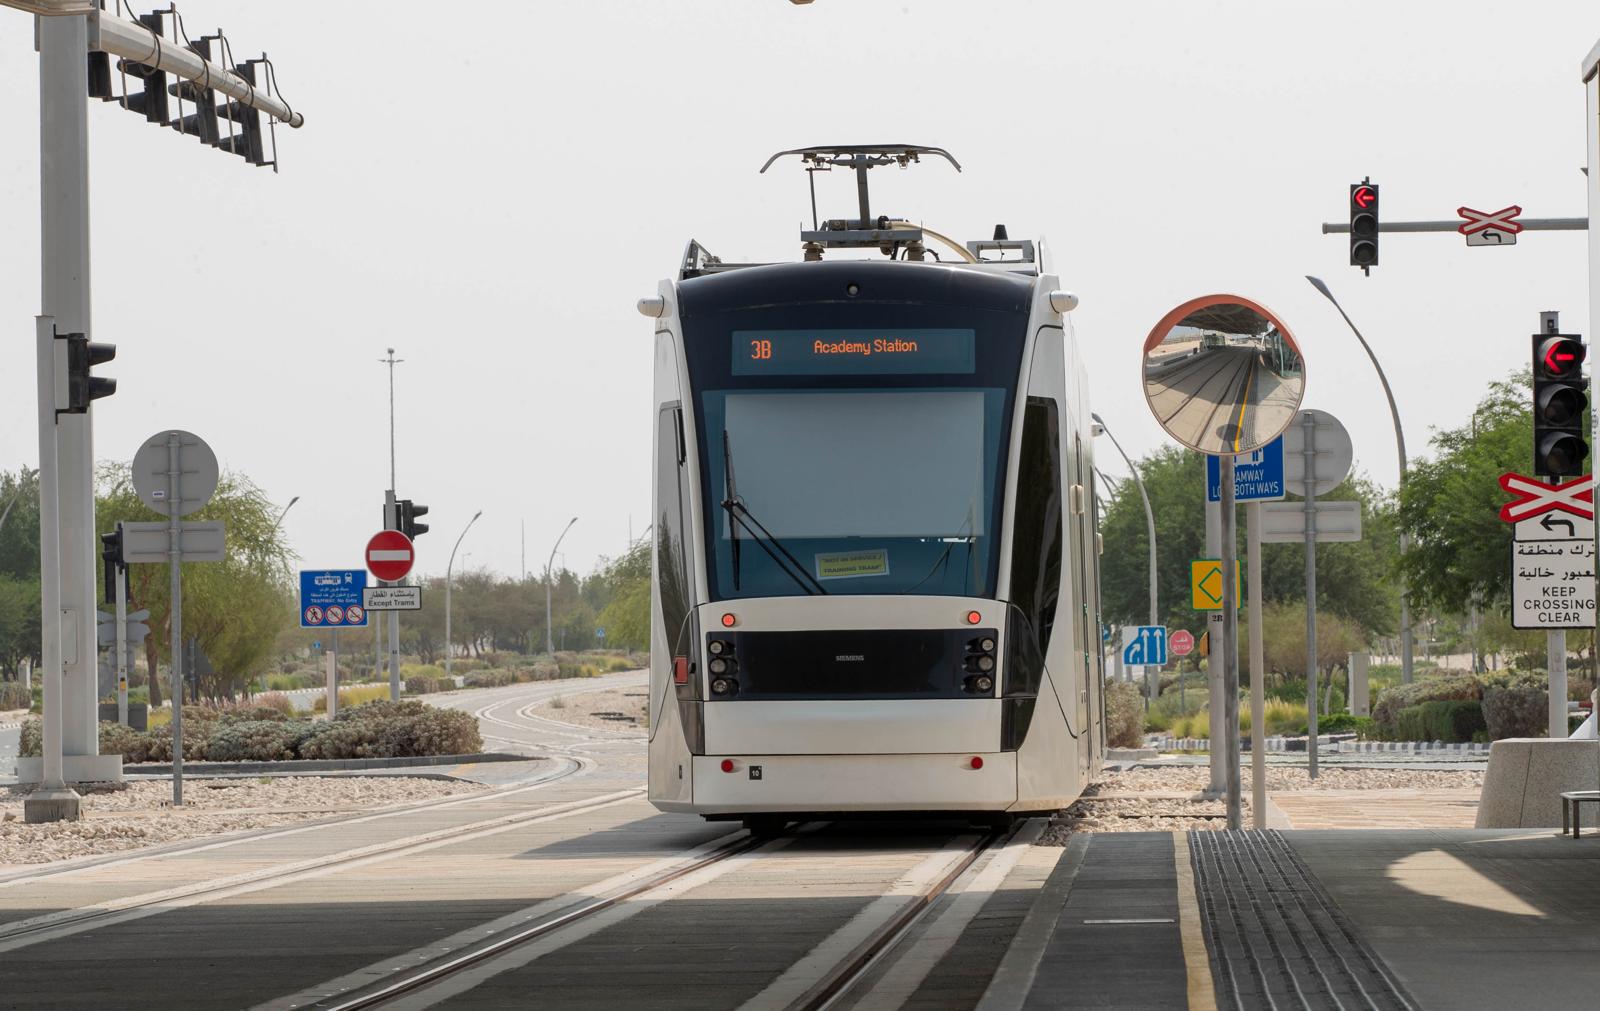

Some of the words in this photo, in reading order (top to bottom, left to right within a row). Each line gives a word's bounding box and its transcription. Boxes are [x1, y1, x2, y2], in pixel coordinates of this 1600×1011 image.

[751, 340, 771, 359] 3B
[814, 340, 870, 355] Academy
[874, 339, 917, 352] Station
[1235, 469, 1264, 482] AMWAY
[1235, 482, 1255, 496] BOTH
[1256, 481, 1279, 495] WAYS
[1518, 544, 1563, 555] منطقة
[1519, 567, 1555, 580] خالية
[1542, 586, 1576, 597] KEEP
[369, 599, 392, 607] Except
[1523, 599, 1595, 610] CROSSING
[1538, 612, 1580, 622] CLEAR
